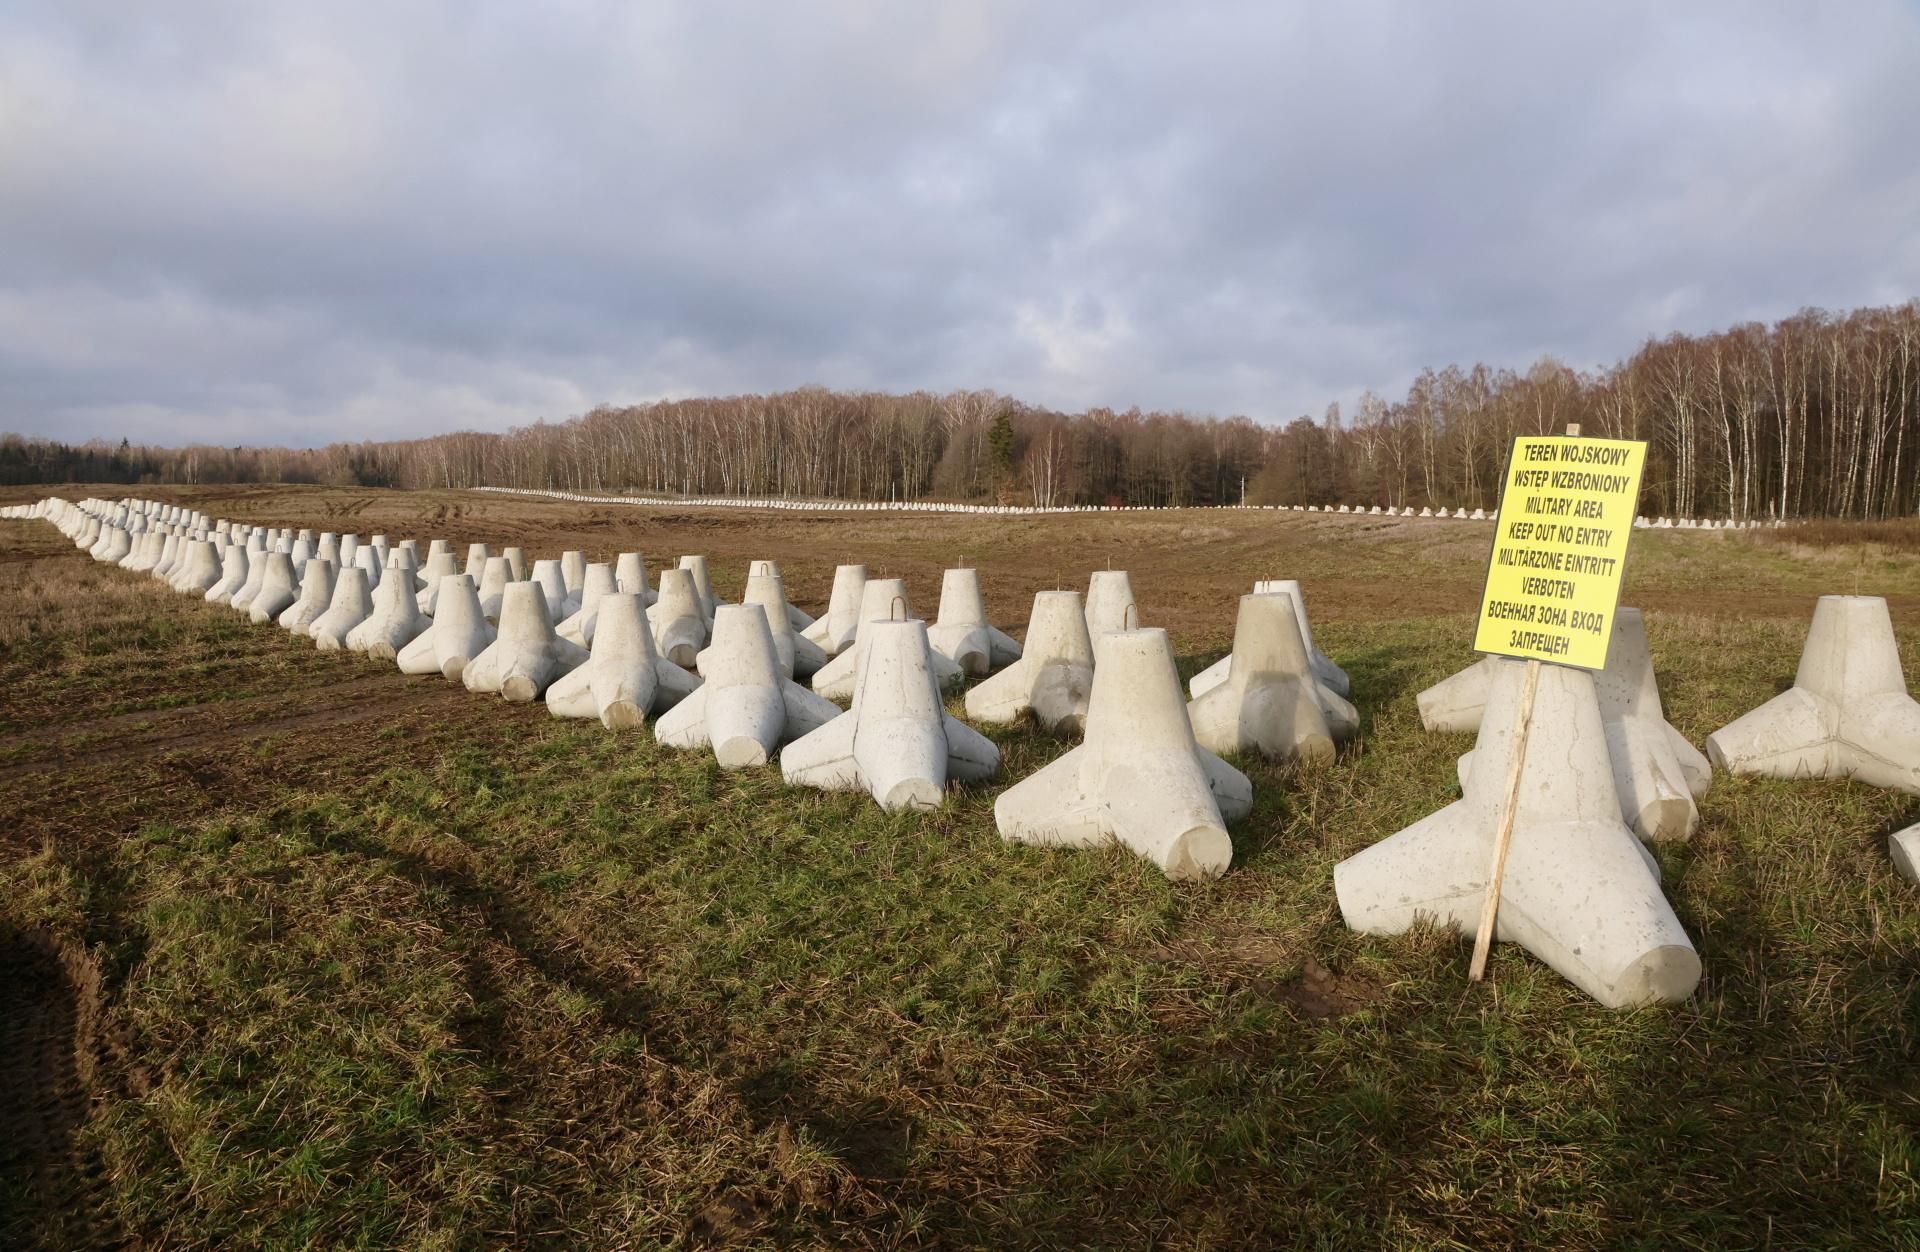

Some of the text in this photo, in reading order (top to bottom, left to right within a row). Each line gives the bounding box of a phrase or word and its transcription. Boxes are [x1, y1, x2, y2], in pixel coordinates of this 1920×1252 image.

[1525, 445, 1629, 466] TEREN WOJSKOWY
[1551, 472, 1629, 494] WZBRONIONY
[1525, 497, 1603, 519] MILITARY AREA
[1509, 522, 1612, 548] KEEP OUT NO ENTRY
[1565, 555, 1616, 576] EINTRITT
[1522, 577, 1575, 600] VERBOTEN
[1488, 600, 1604, 635] ВОЕННАЯ ЗОНА ВХОД
[1510, 630, 1570, 656] ЗАПРЕЩЕН
